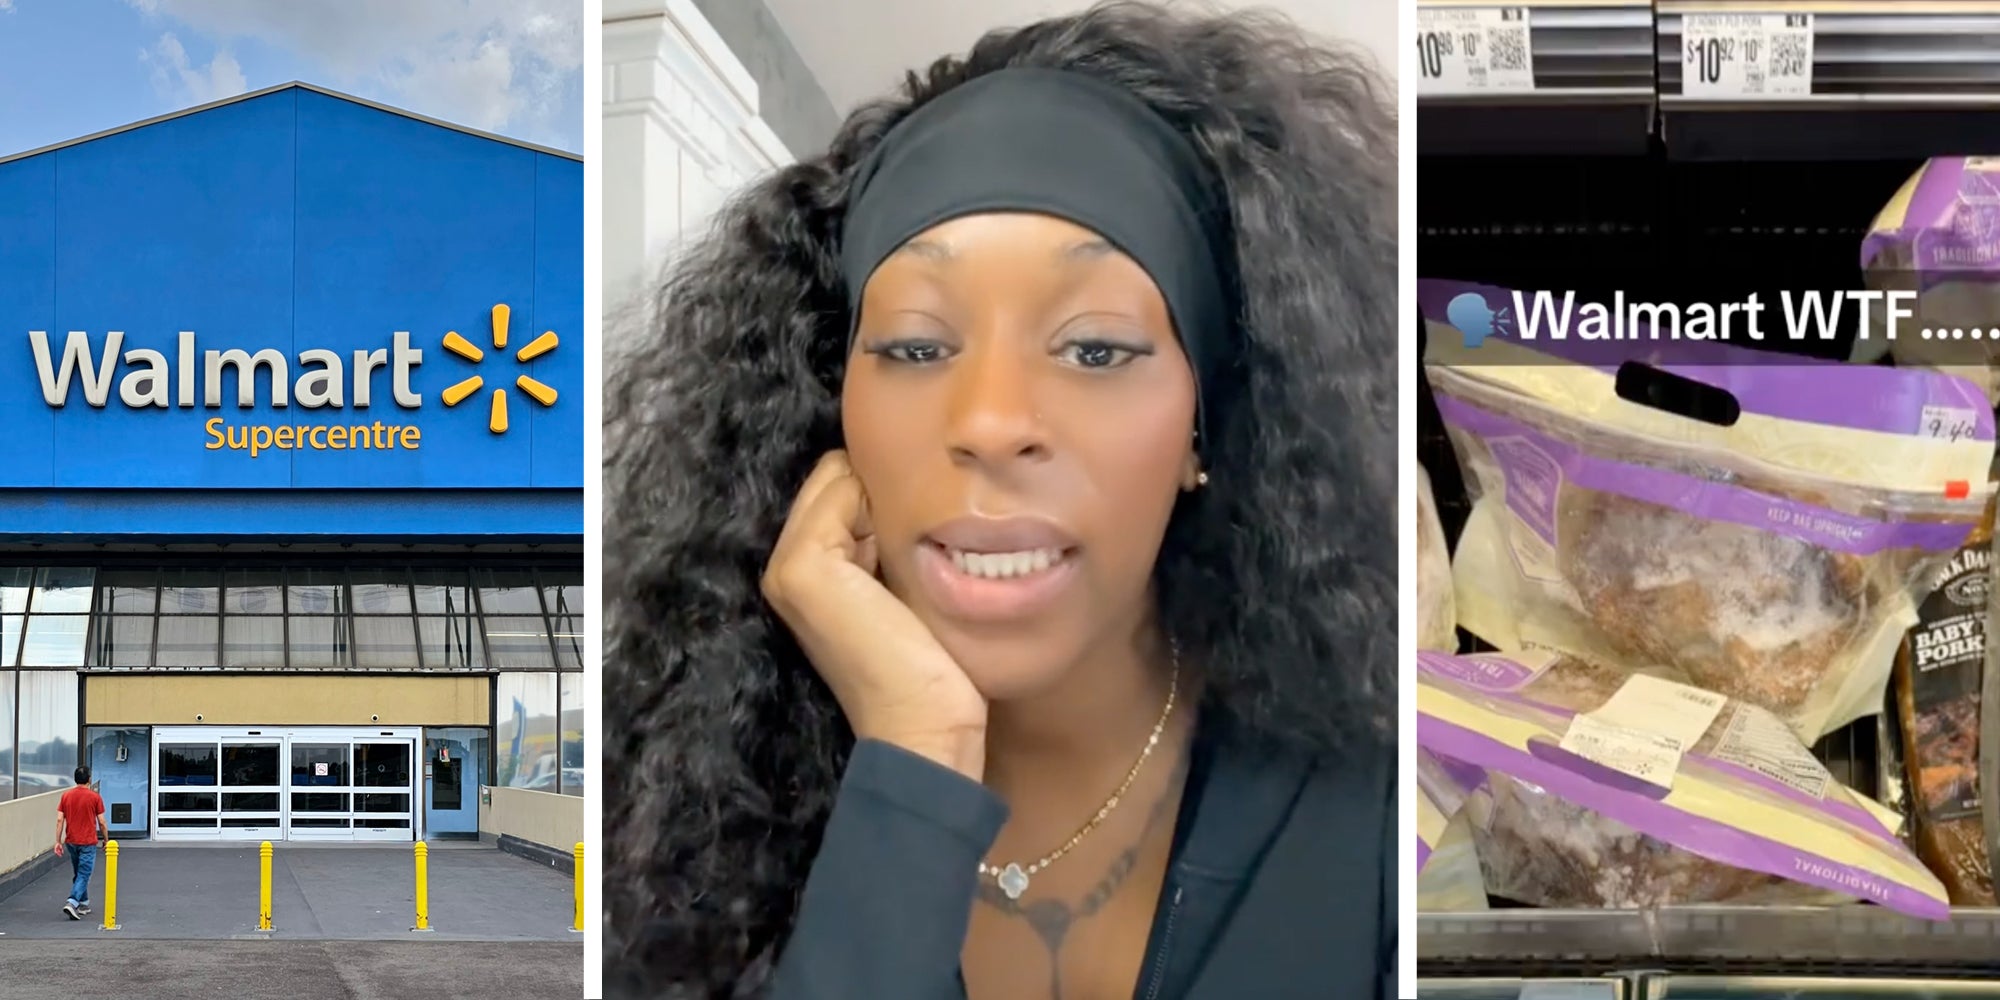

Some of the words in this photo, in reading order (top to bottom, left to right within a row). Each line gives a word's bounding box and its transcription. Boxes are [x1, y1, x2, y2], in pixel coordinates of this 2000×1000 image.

[29, 331, 422, 408] Walmart
[205, 418, 421, 457] Supercentre
[1767, 507, 1791, 523] KEEP
[1792, 512, 1812, 530] BAG
[1915, 619, 1974, 649] BABY
[1916, 634, 1985, 666] PORK
[1795, 857, 1888, 900] TRADITIONAL
